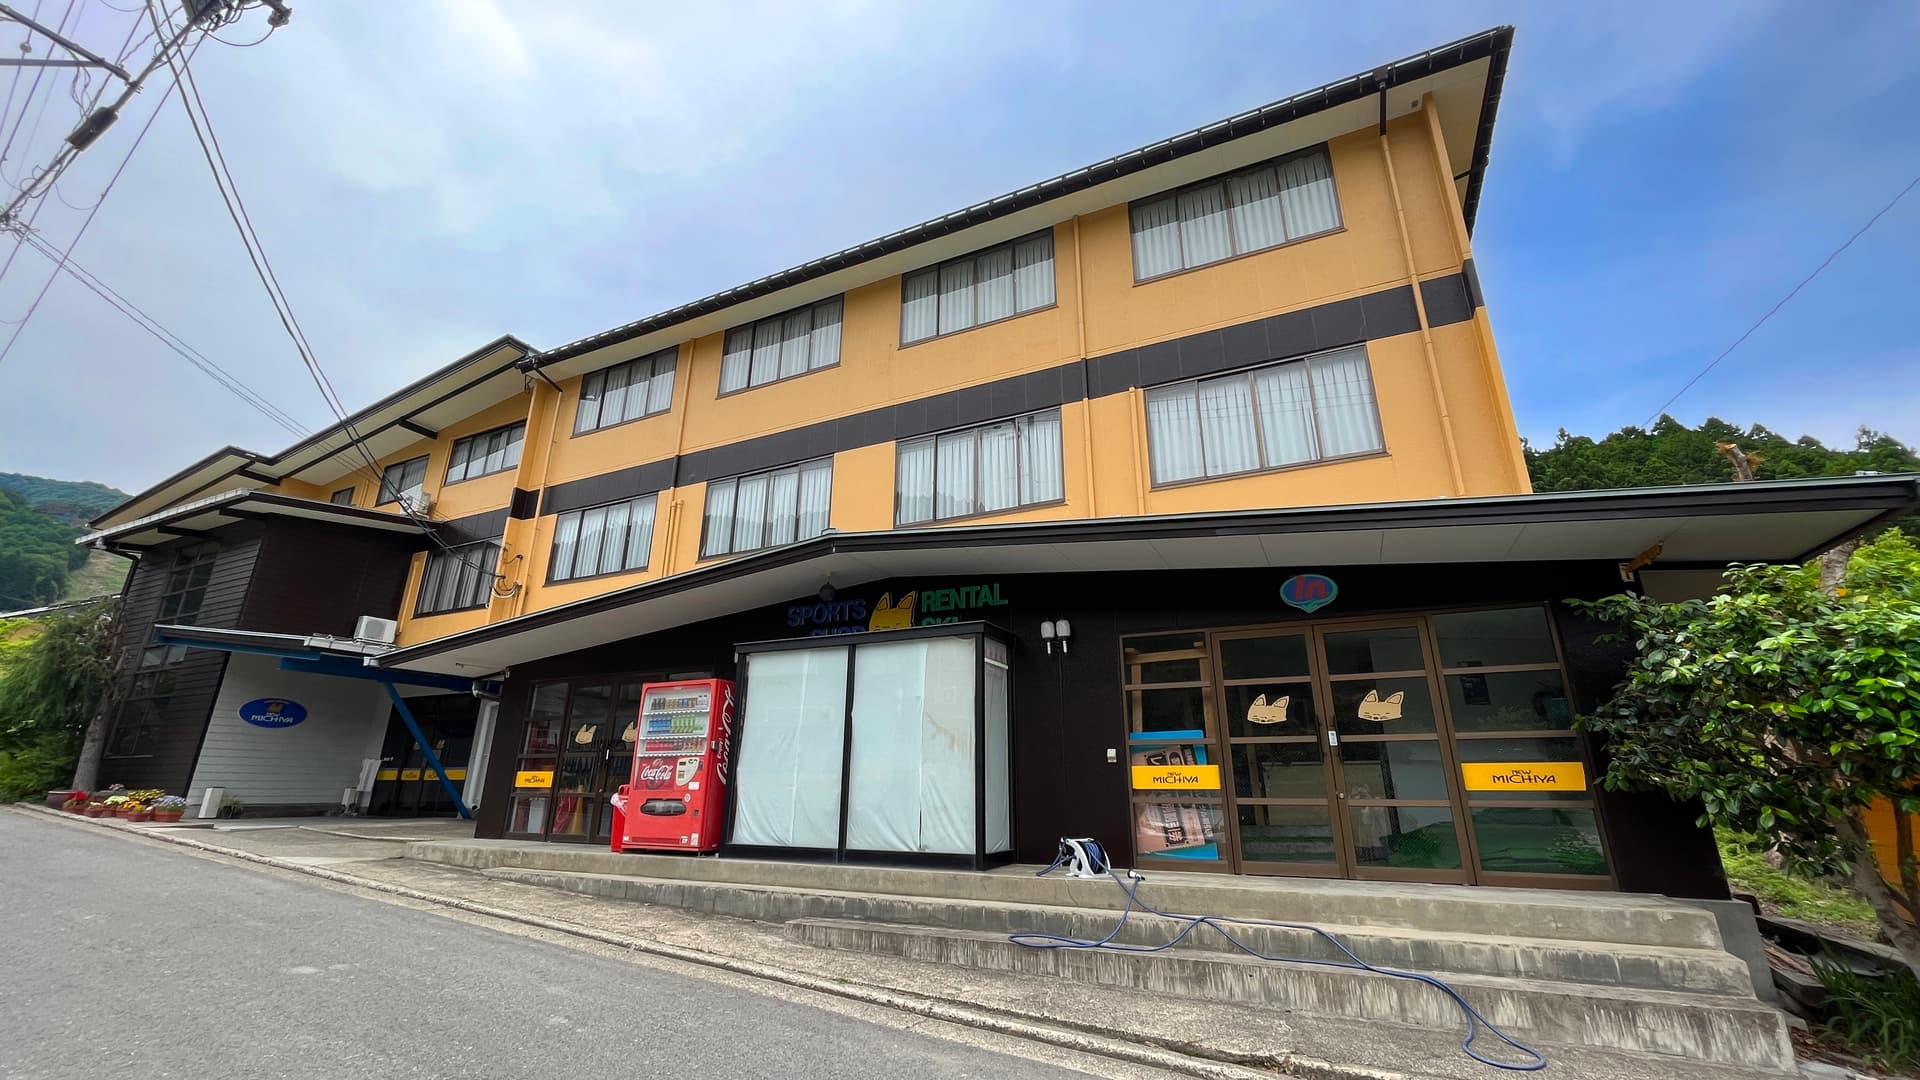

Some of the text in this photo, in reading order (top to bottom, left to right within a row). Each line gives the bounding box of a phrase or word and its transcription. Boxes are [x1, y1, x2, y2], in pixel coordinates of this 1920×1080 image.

[1294, 574, 1329, 601] In
[921, 583, 1009, 612] RENTAL
[786, 599, 867, 627] SPORTS
[251, 715, 293, 723] MICHIYA
[1153, 775, 1199, 784] MICHIYA
[1492, 774, 1556, 784] MICHIYA
